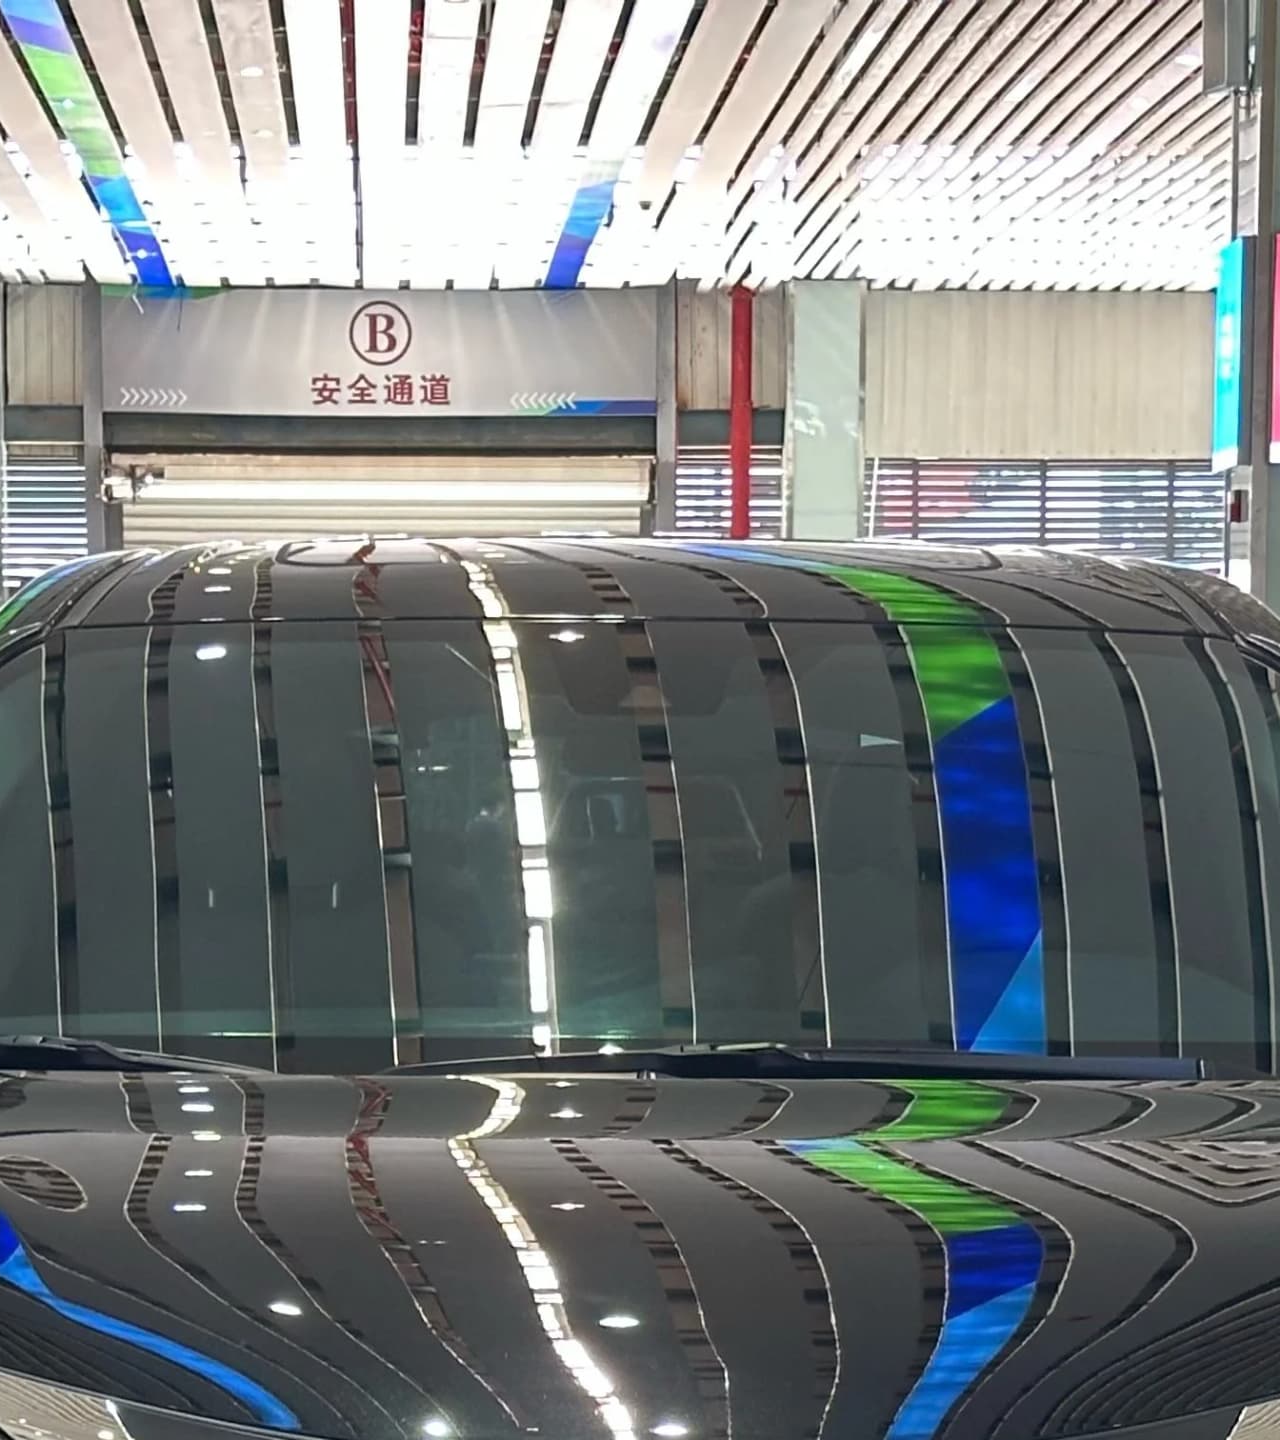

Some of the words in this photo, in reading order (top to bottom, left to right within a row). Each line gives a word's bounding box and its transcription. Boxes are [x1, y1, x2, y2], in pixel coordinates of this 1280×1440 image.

[363, 312, 398, 354] B
[311, 373, 451, 406] 安全通道
